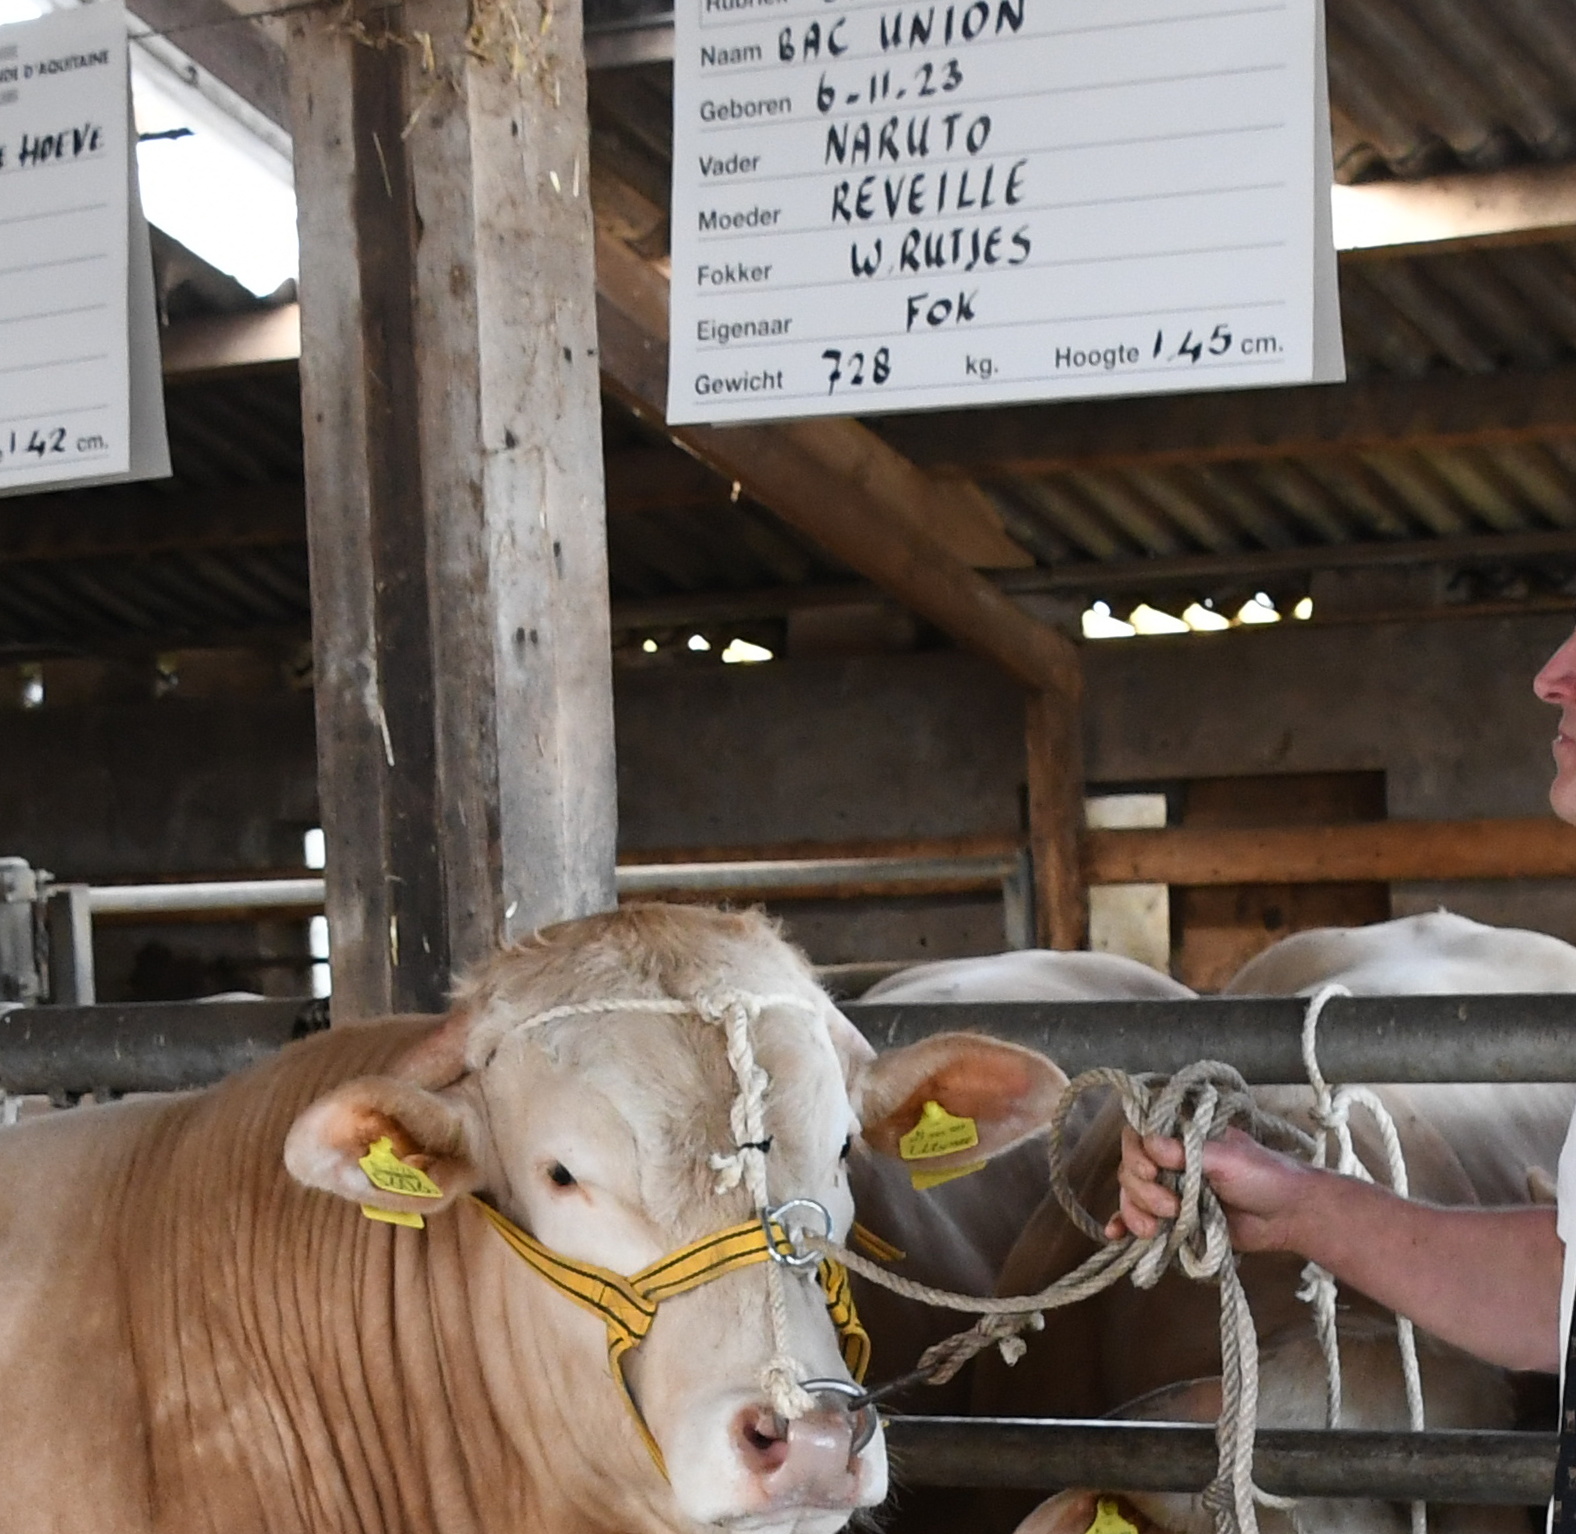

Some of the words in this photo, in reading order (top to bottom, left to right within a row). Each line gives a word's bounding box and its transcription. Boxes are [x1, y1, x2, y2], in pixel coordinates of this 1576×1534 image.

[700, 44, 762, 67] Naam
[778, 16, 849, 63] BAC
[879, 0, 1025, 53] UNION
[699, 96, 792, 122] Geboren
[19, 122, 104, 167] HOEVE
[698, 153, 762, 178] Vader
[825, 112, 992, 166] NARUTO
[698, 207, 782, 232] Moeder
[831, 158, 1028, 224] REVEILLE
[696, 262, 773, 287] Fokker
[696, 317, 794, 344] Eigenaar
[906, 289, 980, 332] FOK
[694, 370, 784, 396] Gewicht
[821, 347, 892, 396] 728
[965, 354, 999, 379] kg.
[1054, 345, 1140, 370] Hoogte
[1240, 334, 1284, 356] cm.
[76, 434, 109, 453] cm.
